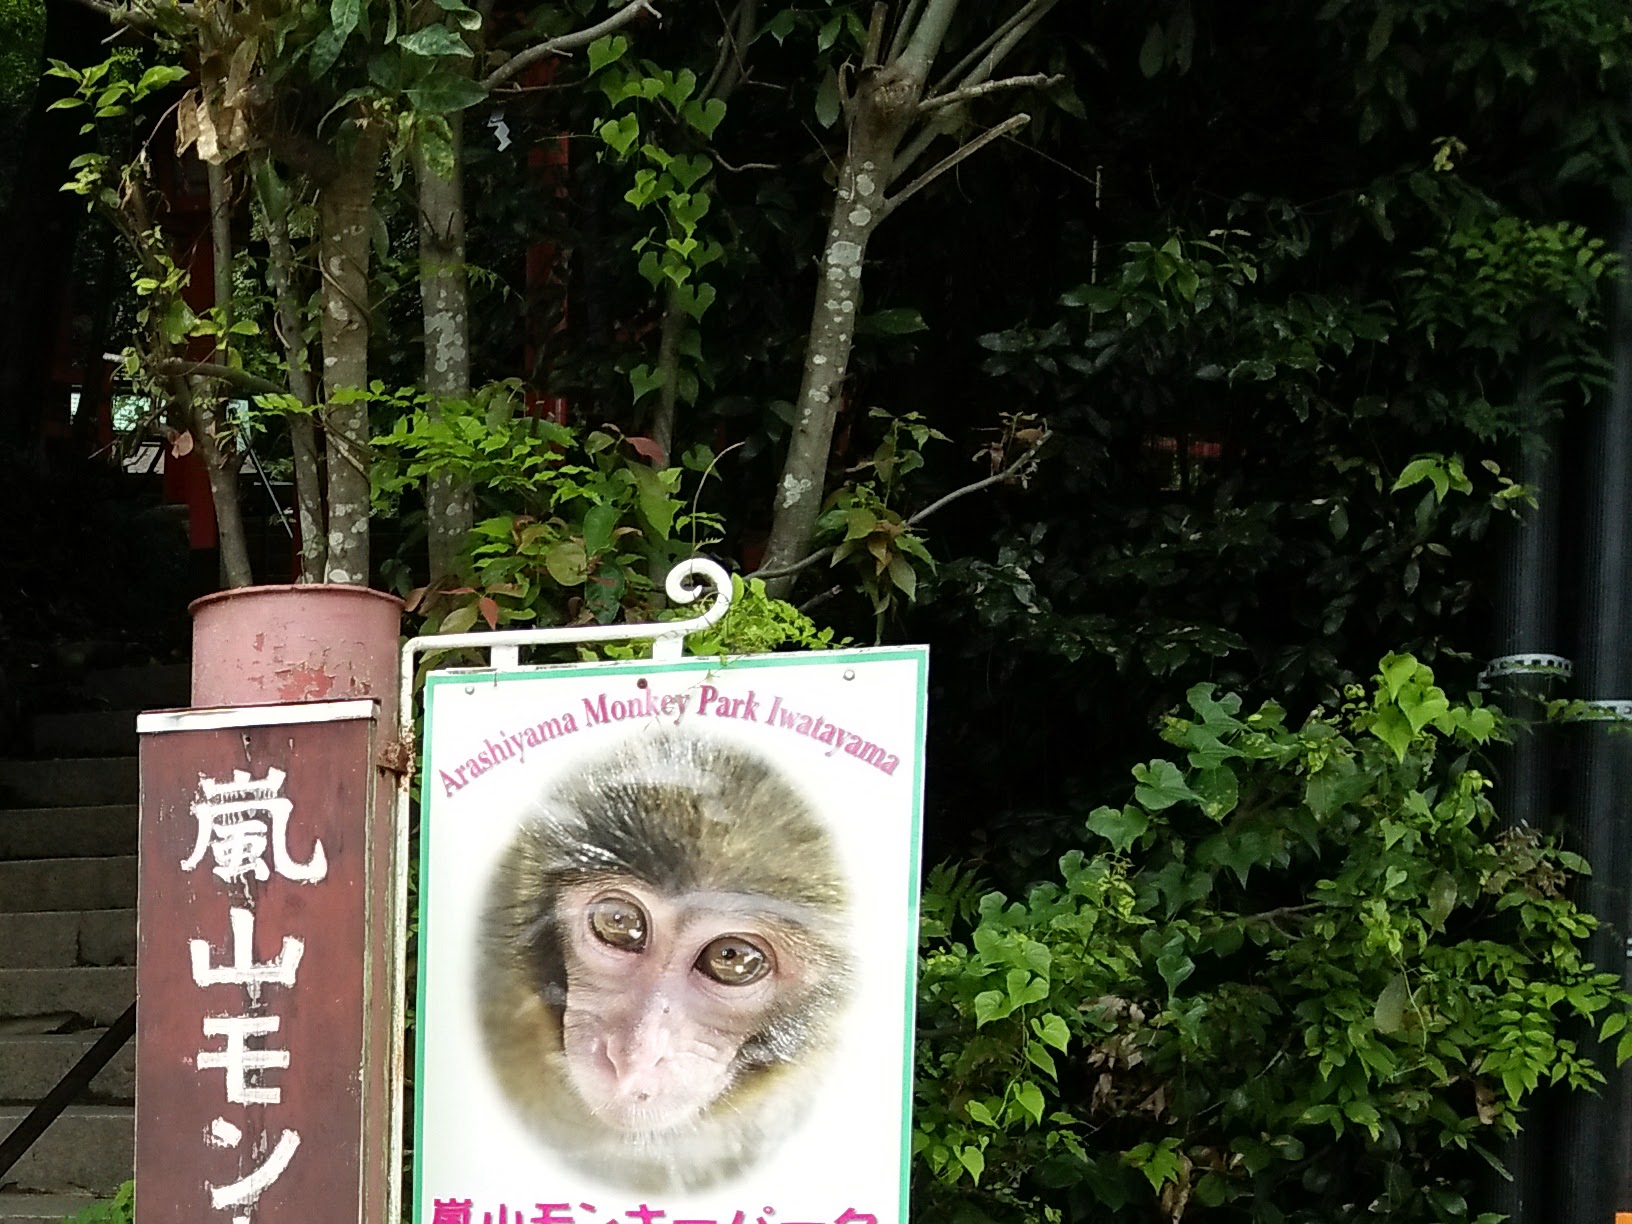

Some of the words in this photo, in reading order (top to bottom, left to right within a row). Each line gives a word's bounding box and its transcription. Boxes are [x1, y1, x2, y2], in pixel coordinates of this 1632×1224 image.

[437, 711, 578, 798] Arashiyama
[581, 686, 691, 726] Monkey
[696, 684, 759, 723] Park
[766, 695, 901, 777] Iwatayama
